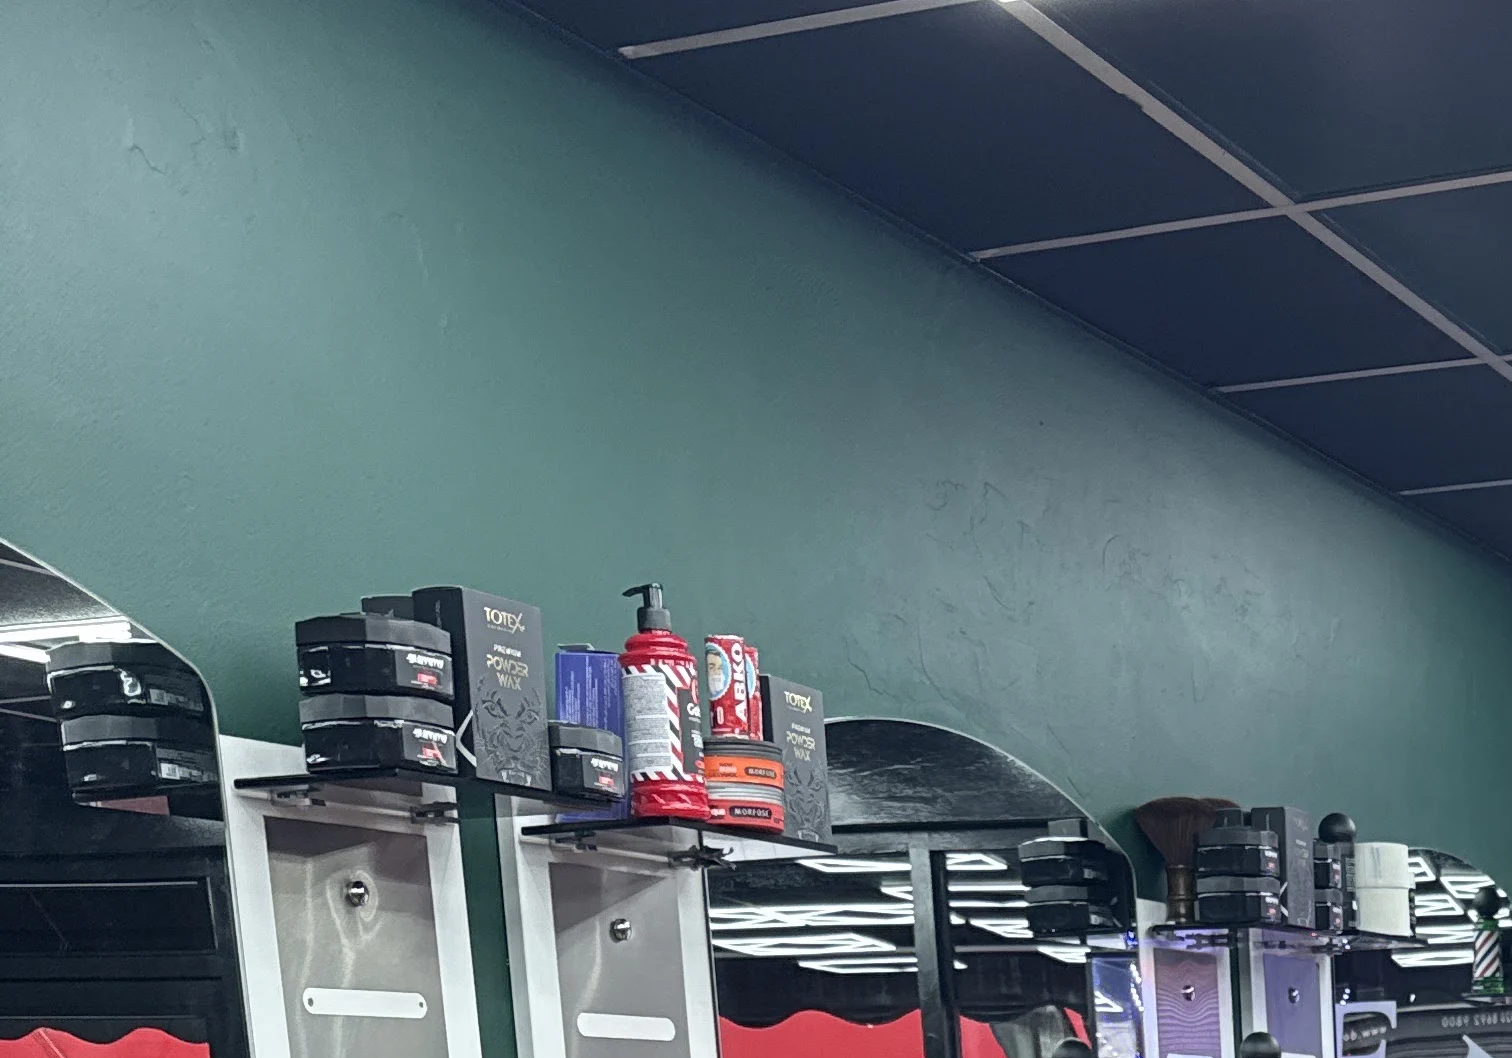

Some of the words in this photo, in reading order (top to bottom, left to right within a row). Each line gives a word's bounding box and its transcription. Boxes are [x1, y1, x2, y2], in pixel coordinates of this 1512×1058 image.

[484, 606, 523, 634] TOTEX
[486, 653, 529, 678] POWDER
[496, 671, 522, 691] WAX
[784, 690, 812, 713] TOTEX
